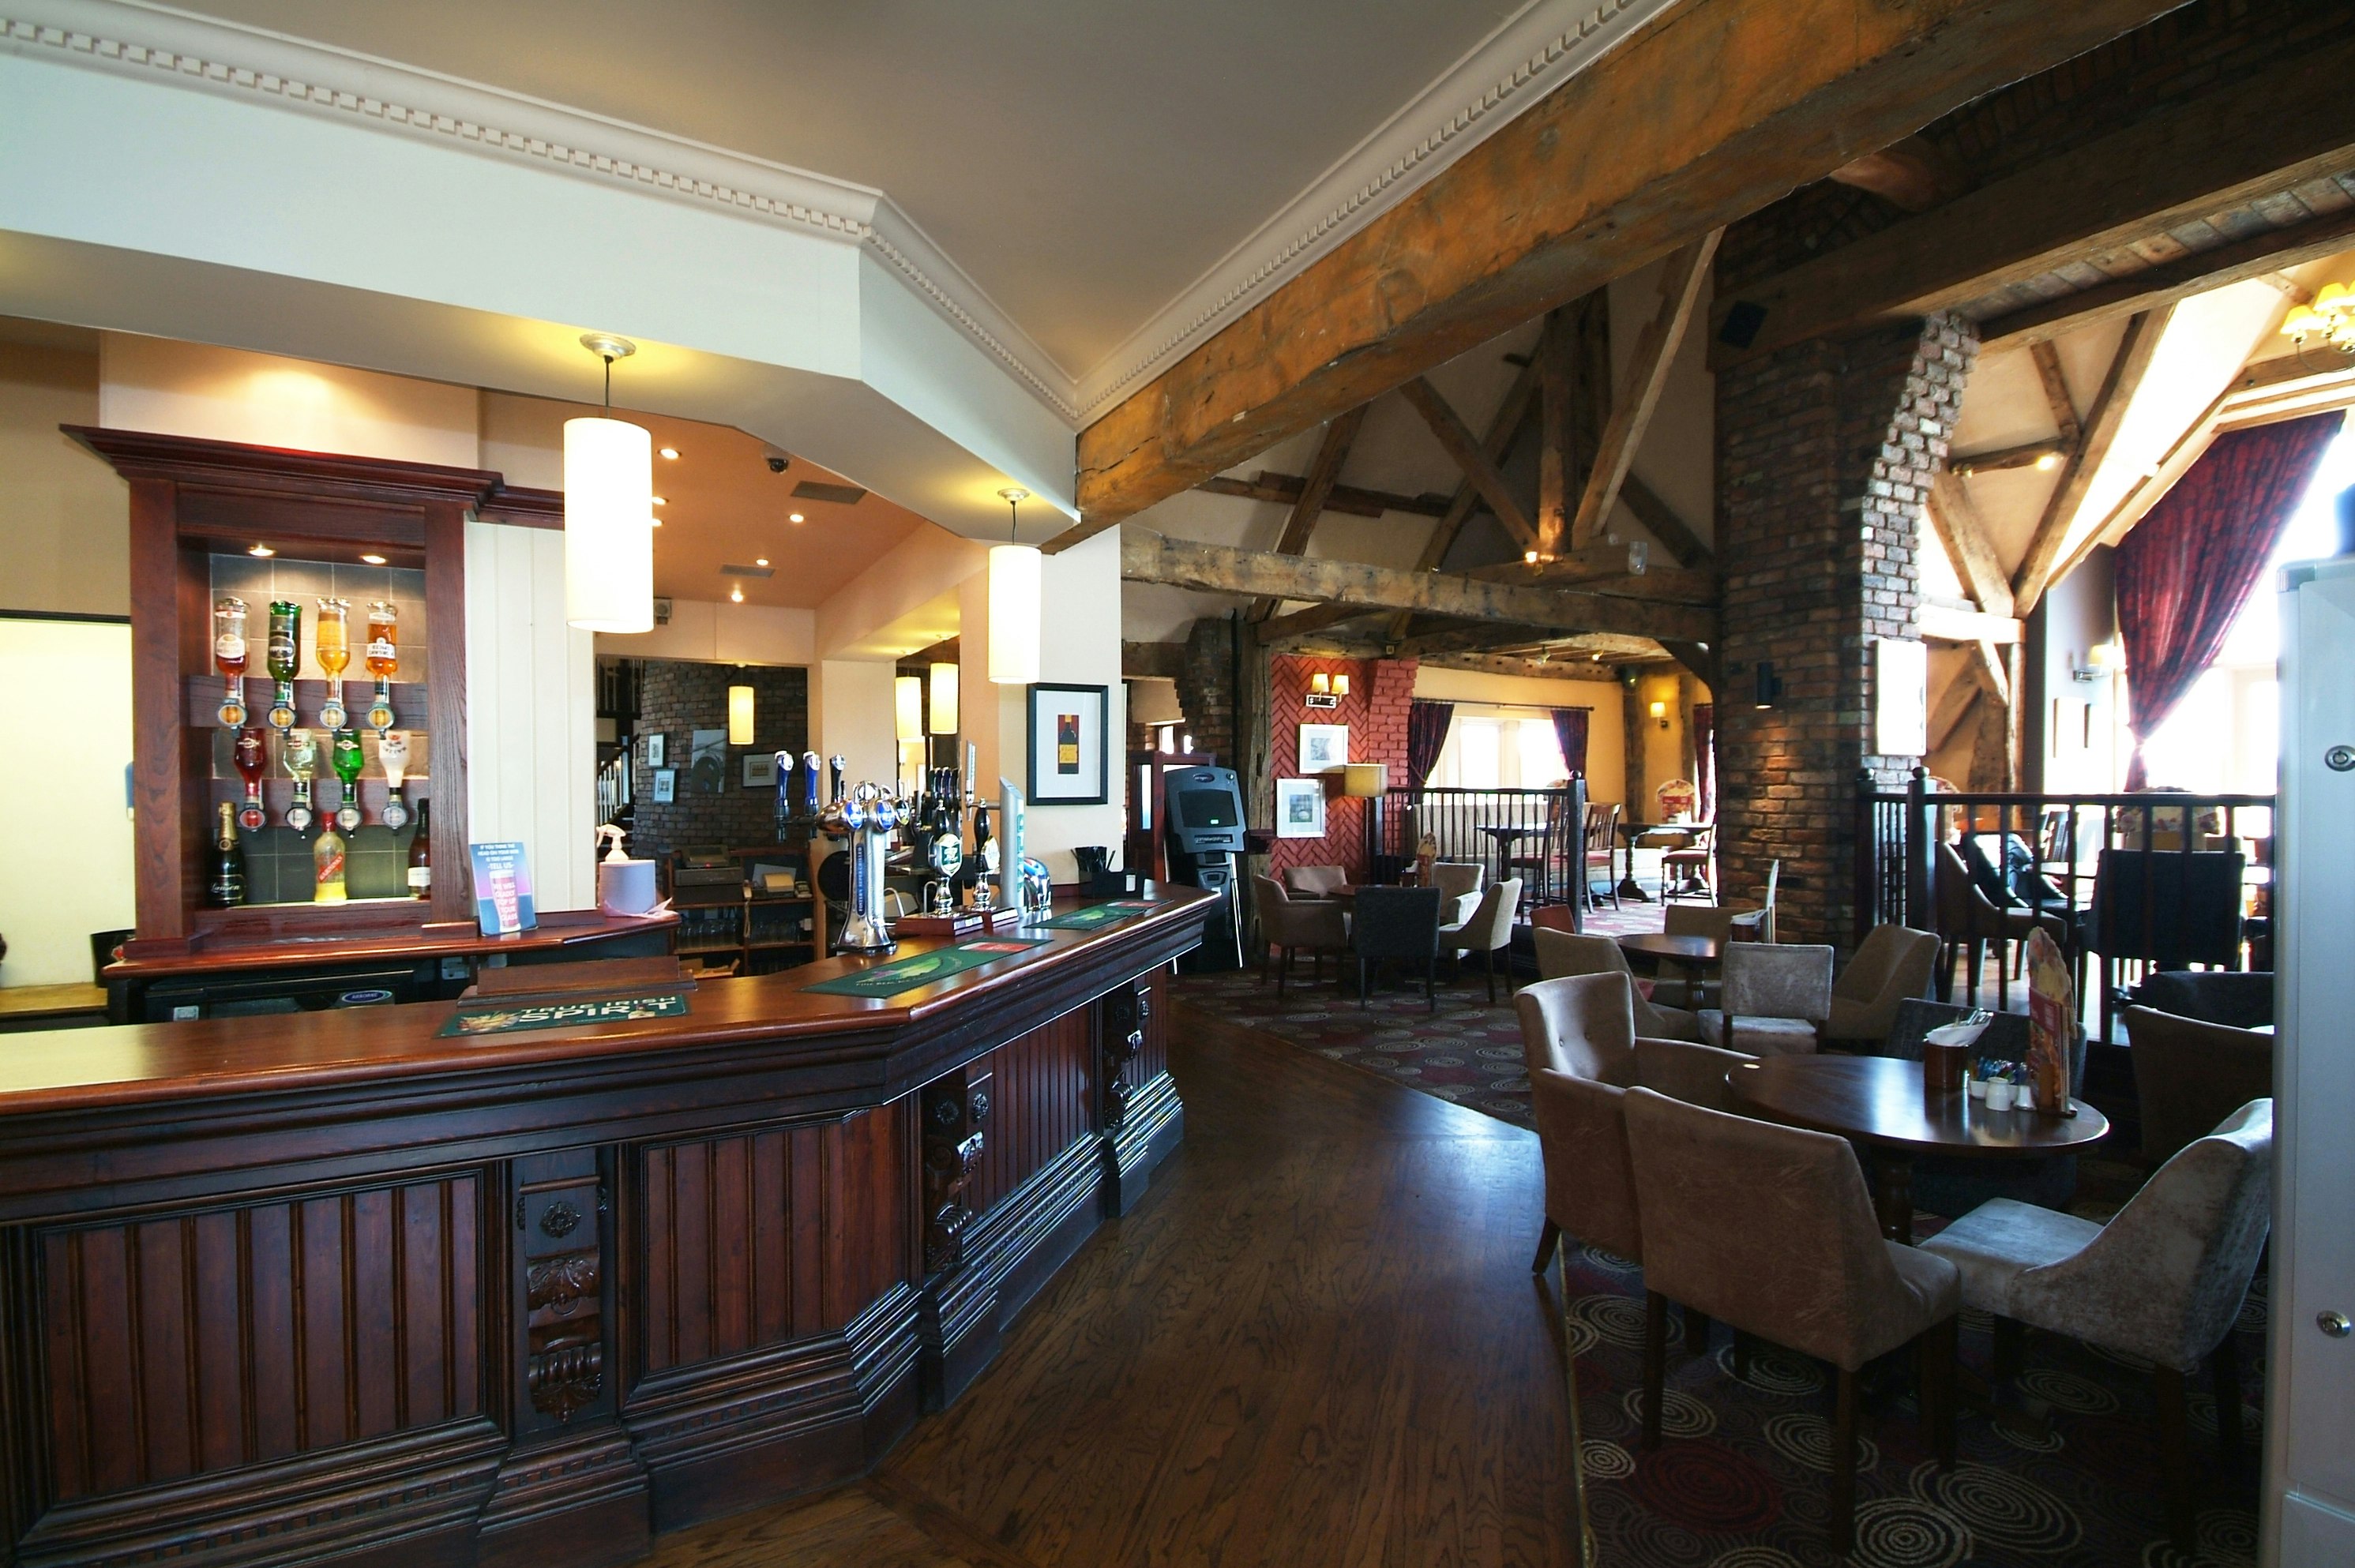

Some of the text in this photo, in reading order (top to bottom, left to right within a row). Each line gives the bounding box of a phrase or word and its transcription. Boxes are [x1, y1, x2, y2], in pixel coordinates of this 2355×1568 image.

[518, 1000, 678, 1023] SPIRT
[520, 996, 676, 1015] TRUE IRISH
